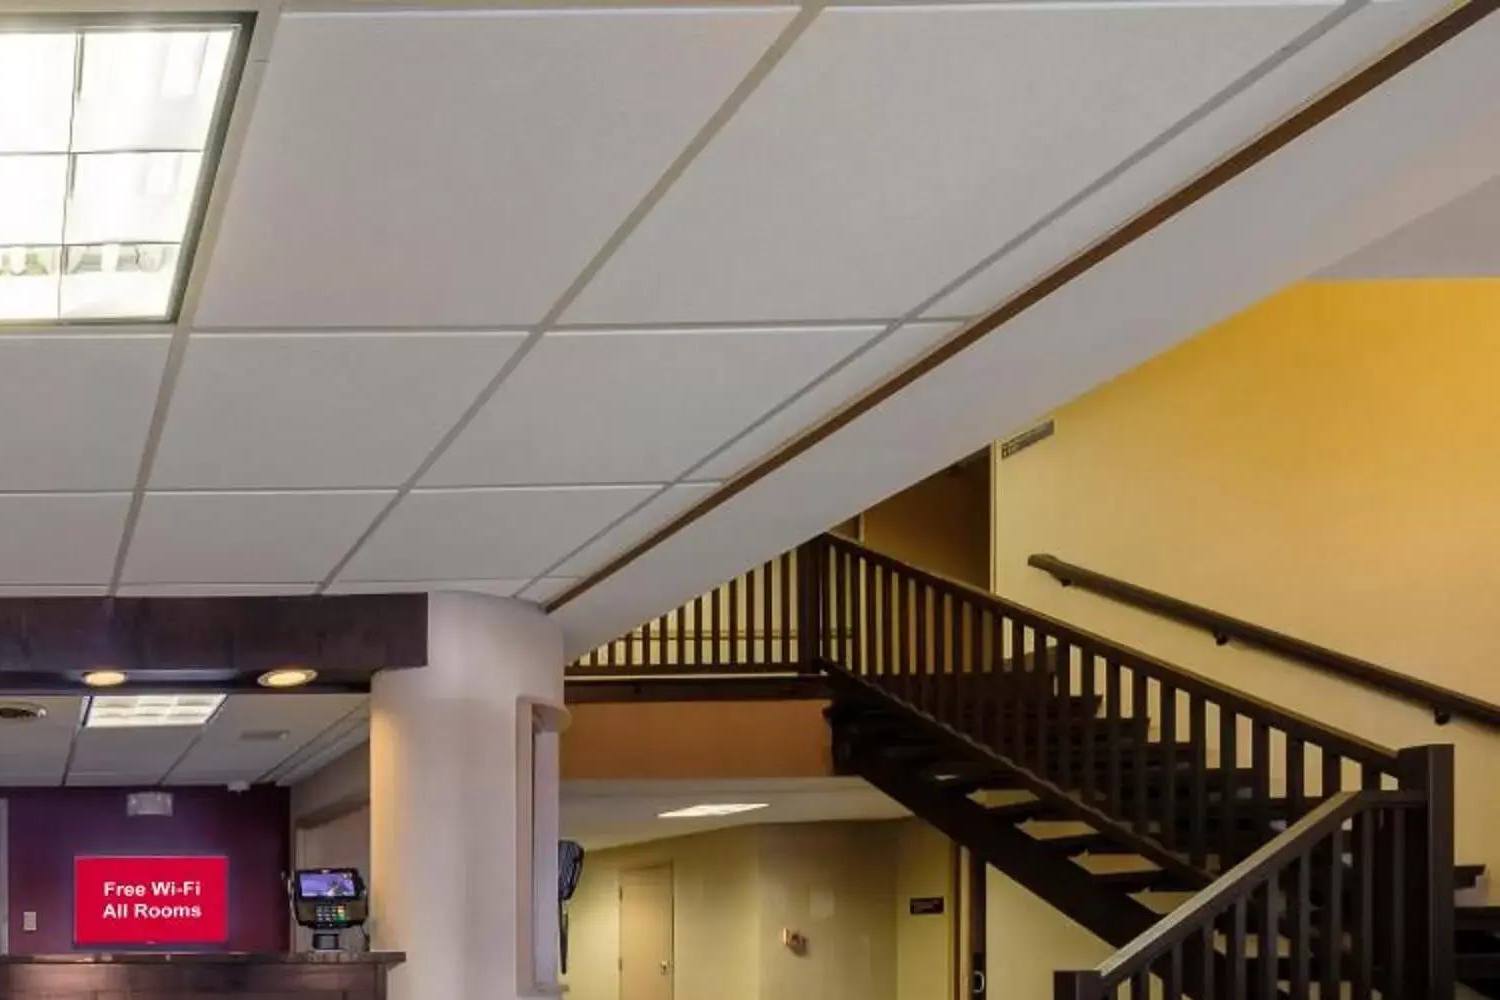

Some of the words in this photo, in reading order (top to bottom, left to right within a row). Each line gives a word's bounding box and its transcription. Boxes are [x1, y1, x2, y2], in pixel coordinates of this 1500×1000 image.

[103, 881, 146, 897] Free
[151, 881, 201, 897] Wi-Fi
[103, 903, 128, 919] All
[134, 903, 202, 919] Rooms
